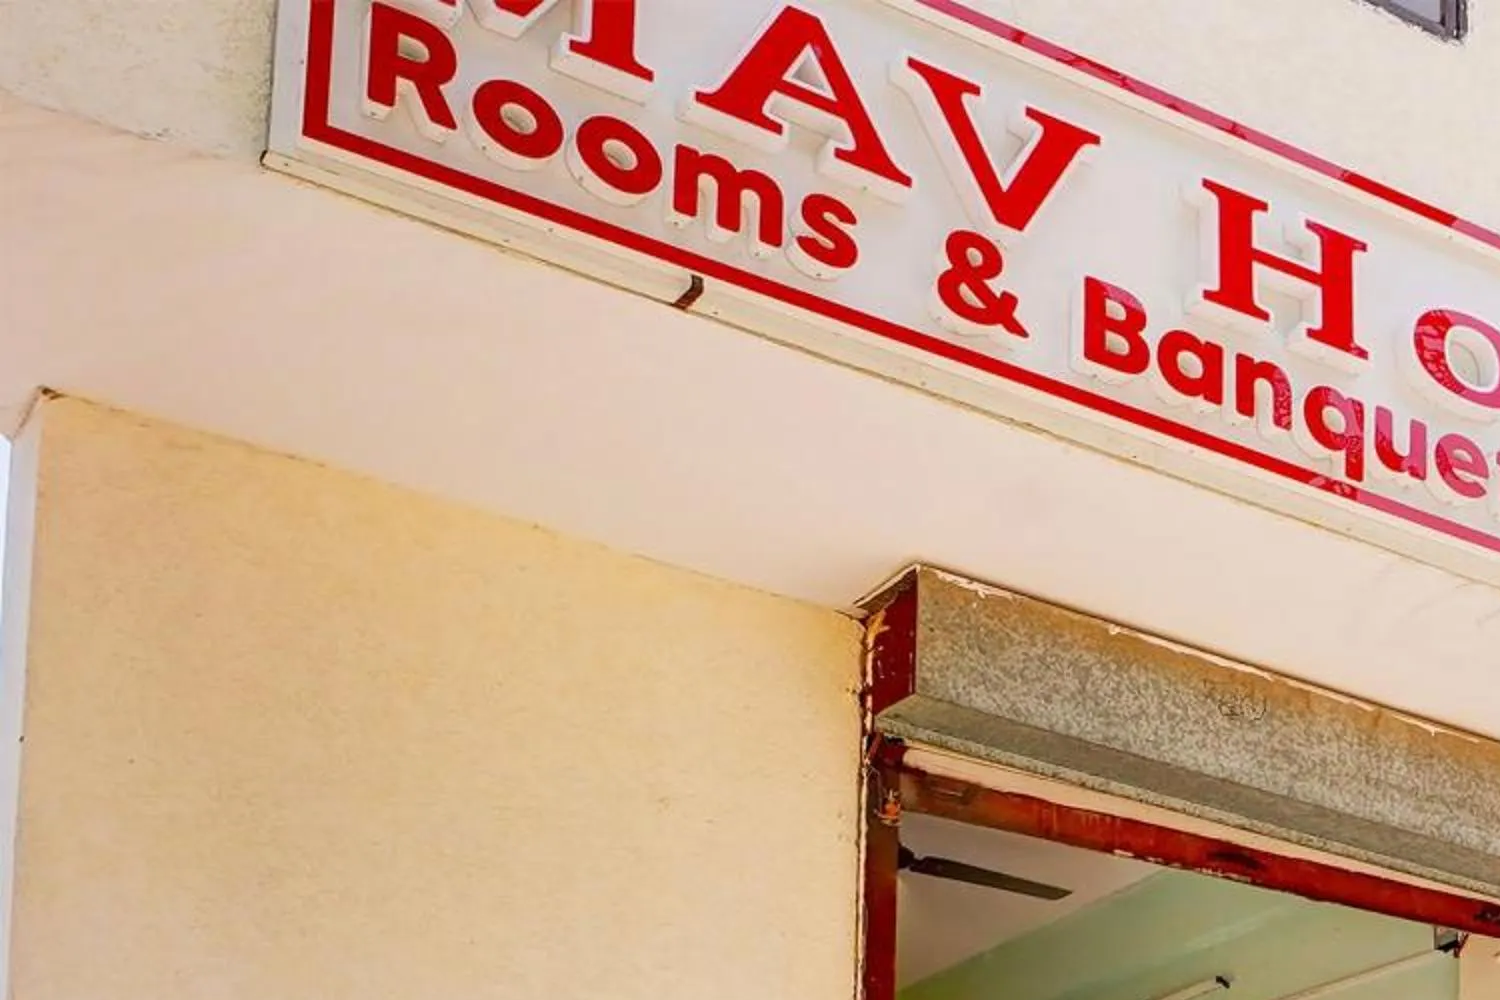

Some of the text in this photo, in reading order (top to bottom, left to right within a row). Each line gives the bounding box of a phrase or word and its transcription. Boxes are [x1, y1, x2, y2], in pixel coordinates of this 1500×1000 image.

[367, 1, 859, 269] Rooms
[937, 230, 1028, 338] &
[436, 0, 1101, 232] AV
